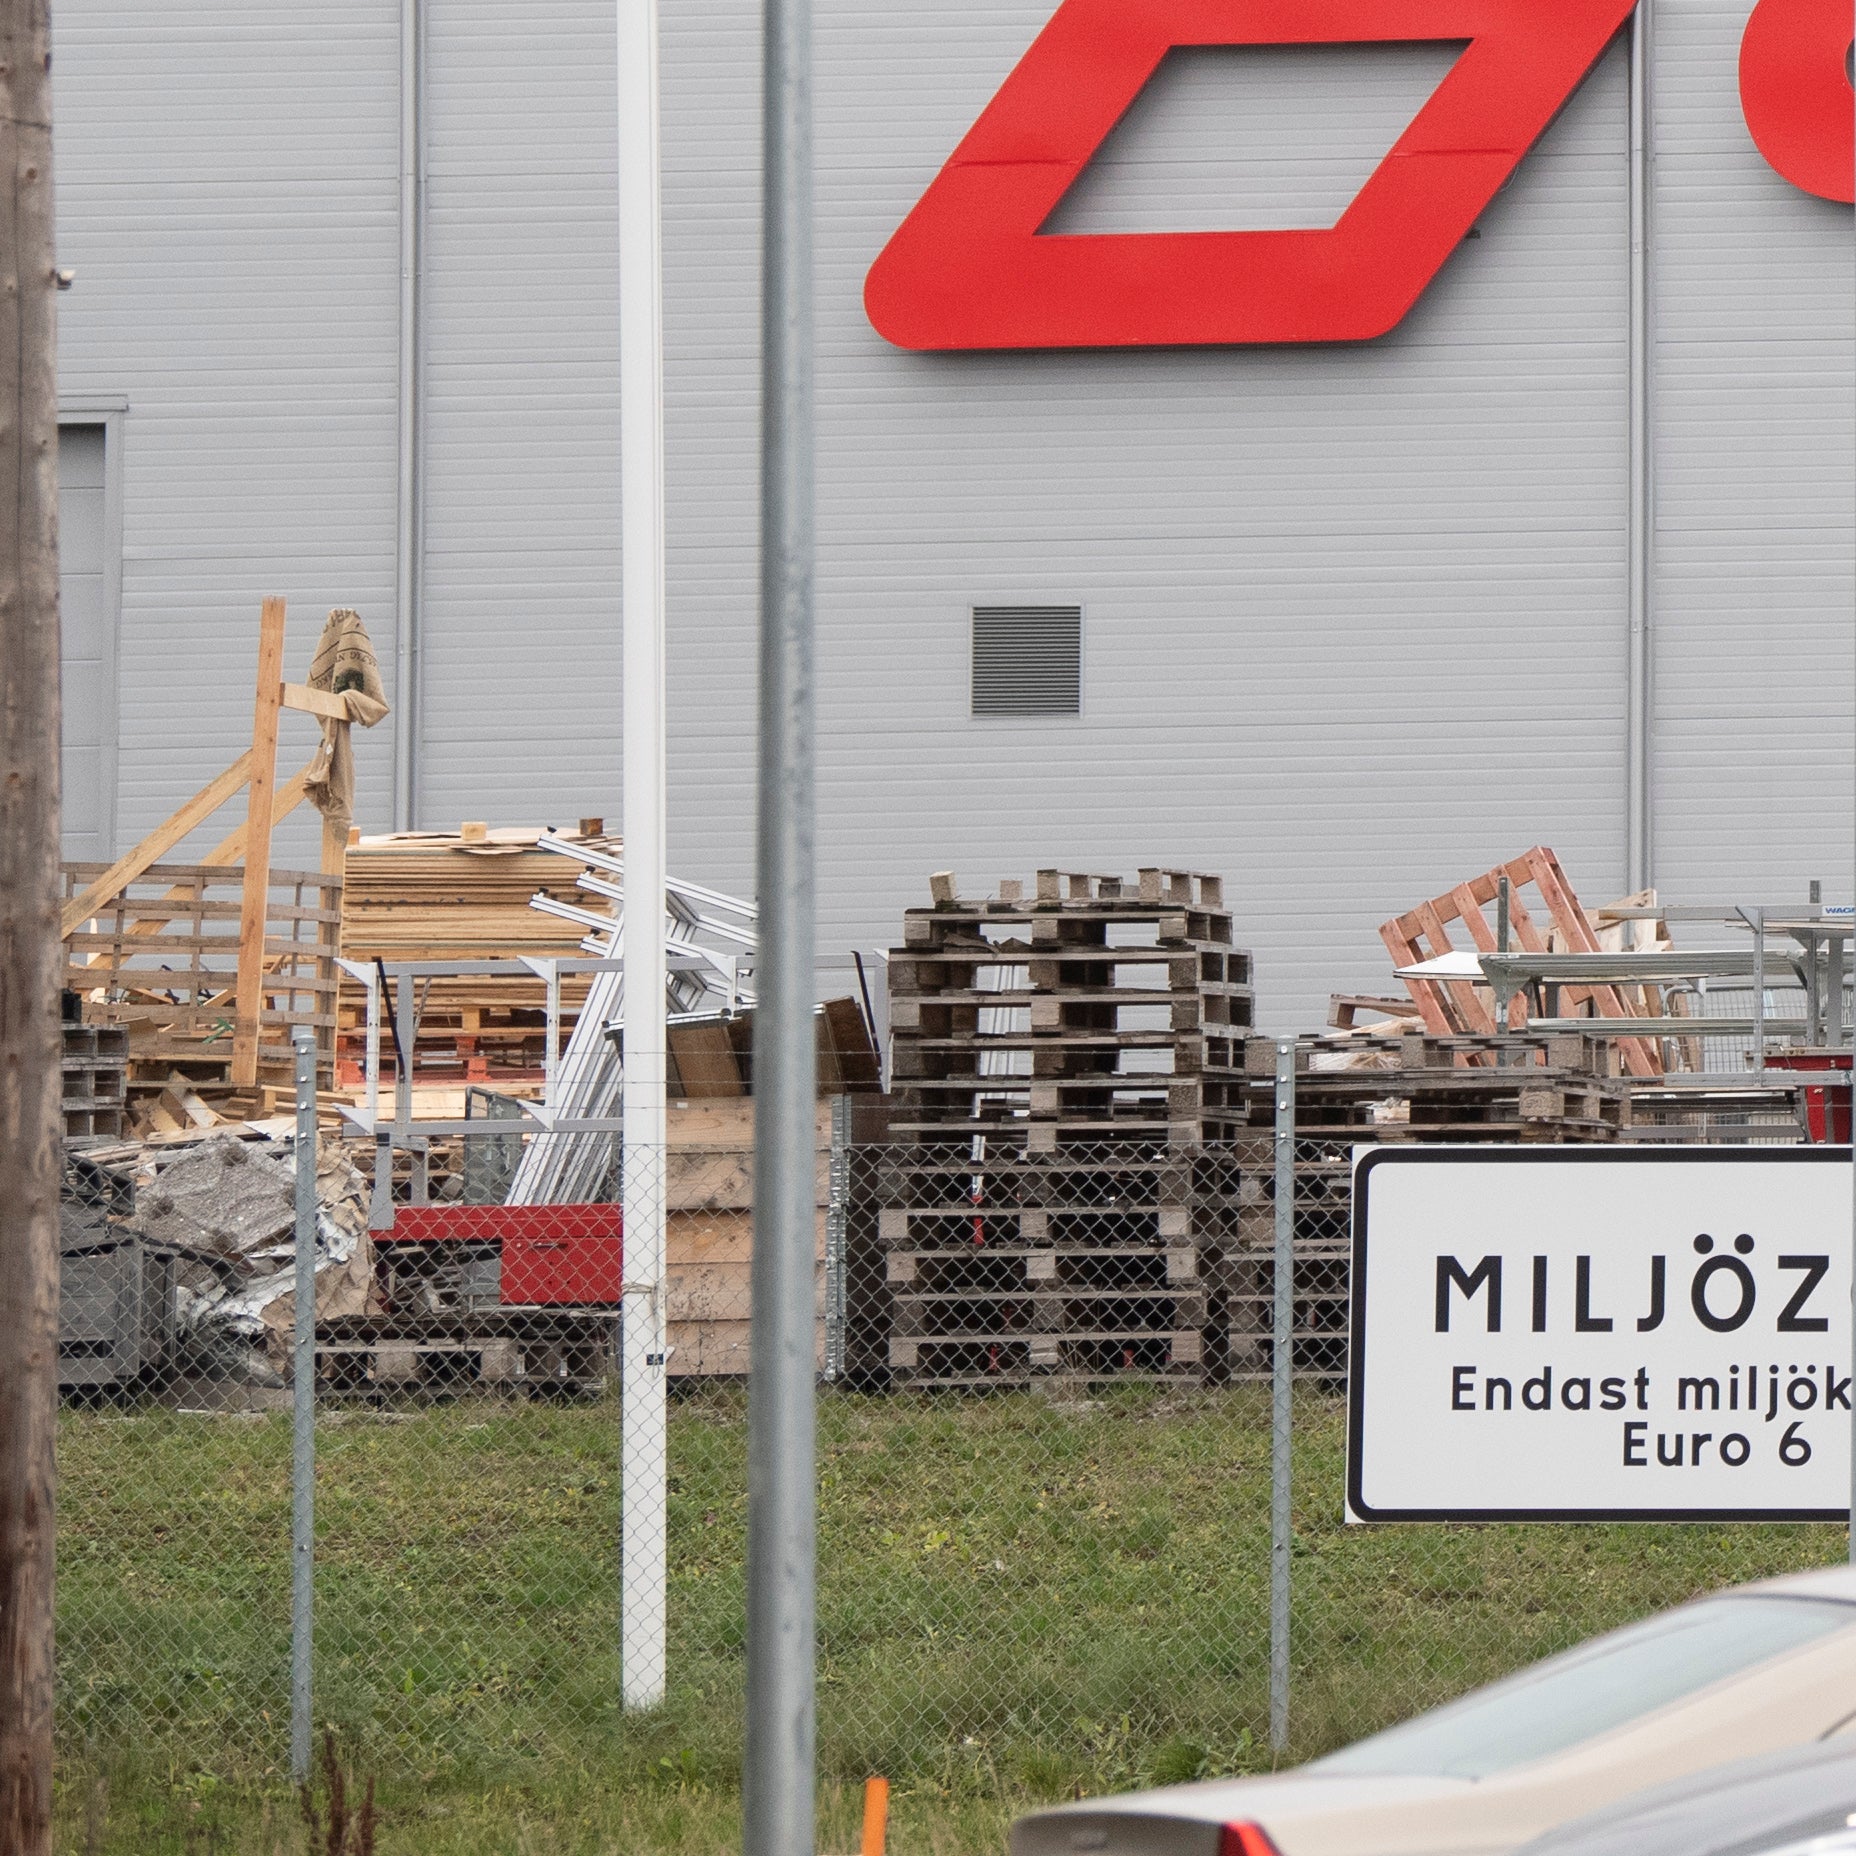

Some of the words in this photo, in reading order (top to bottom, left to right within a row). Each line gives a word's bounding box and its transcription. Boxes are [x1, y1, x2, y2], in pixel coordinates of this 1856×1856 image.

[1452, 1365, 1649, 1412] Endast
[1623, 1421, 1752, 1468] Euro
[1778, 1421, 1812, 1467] 6
